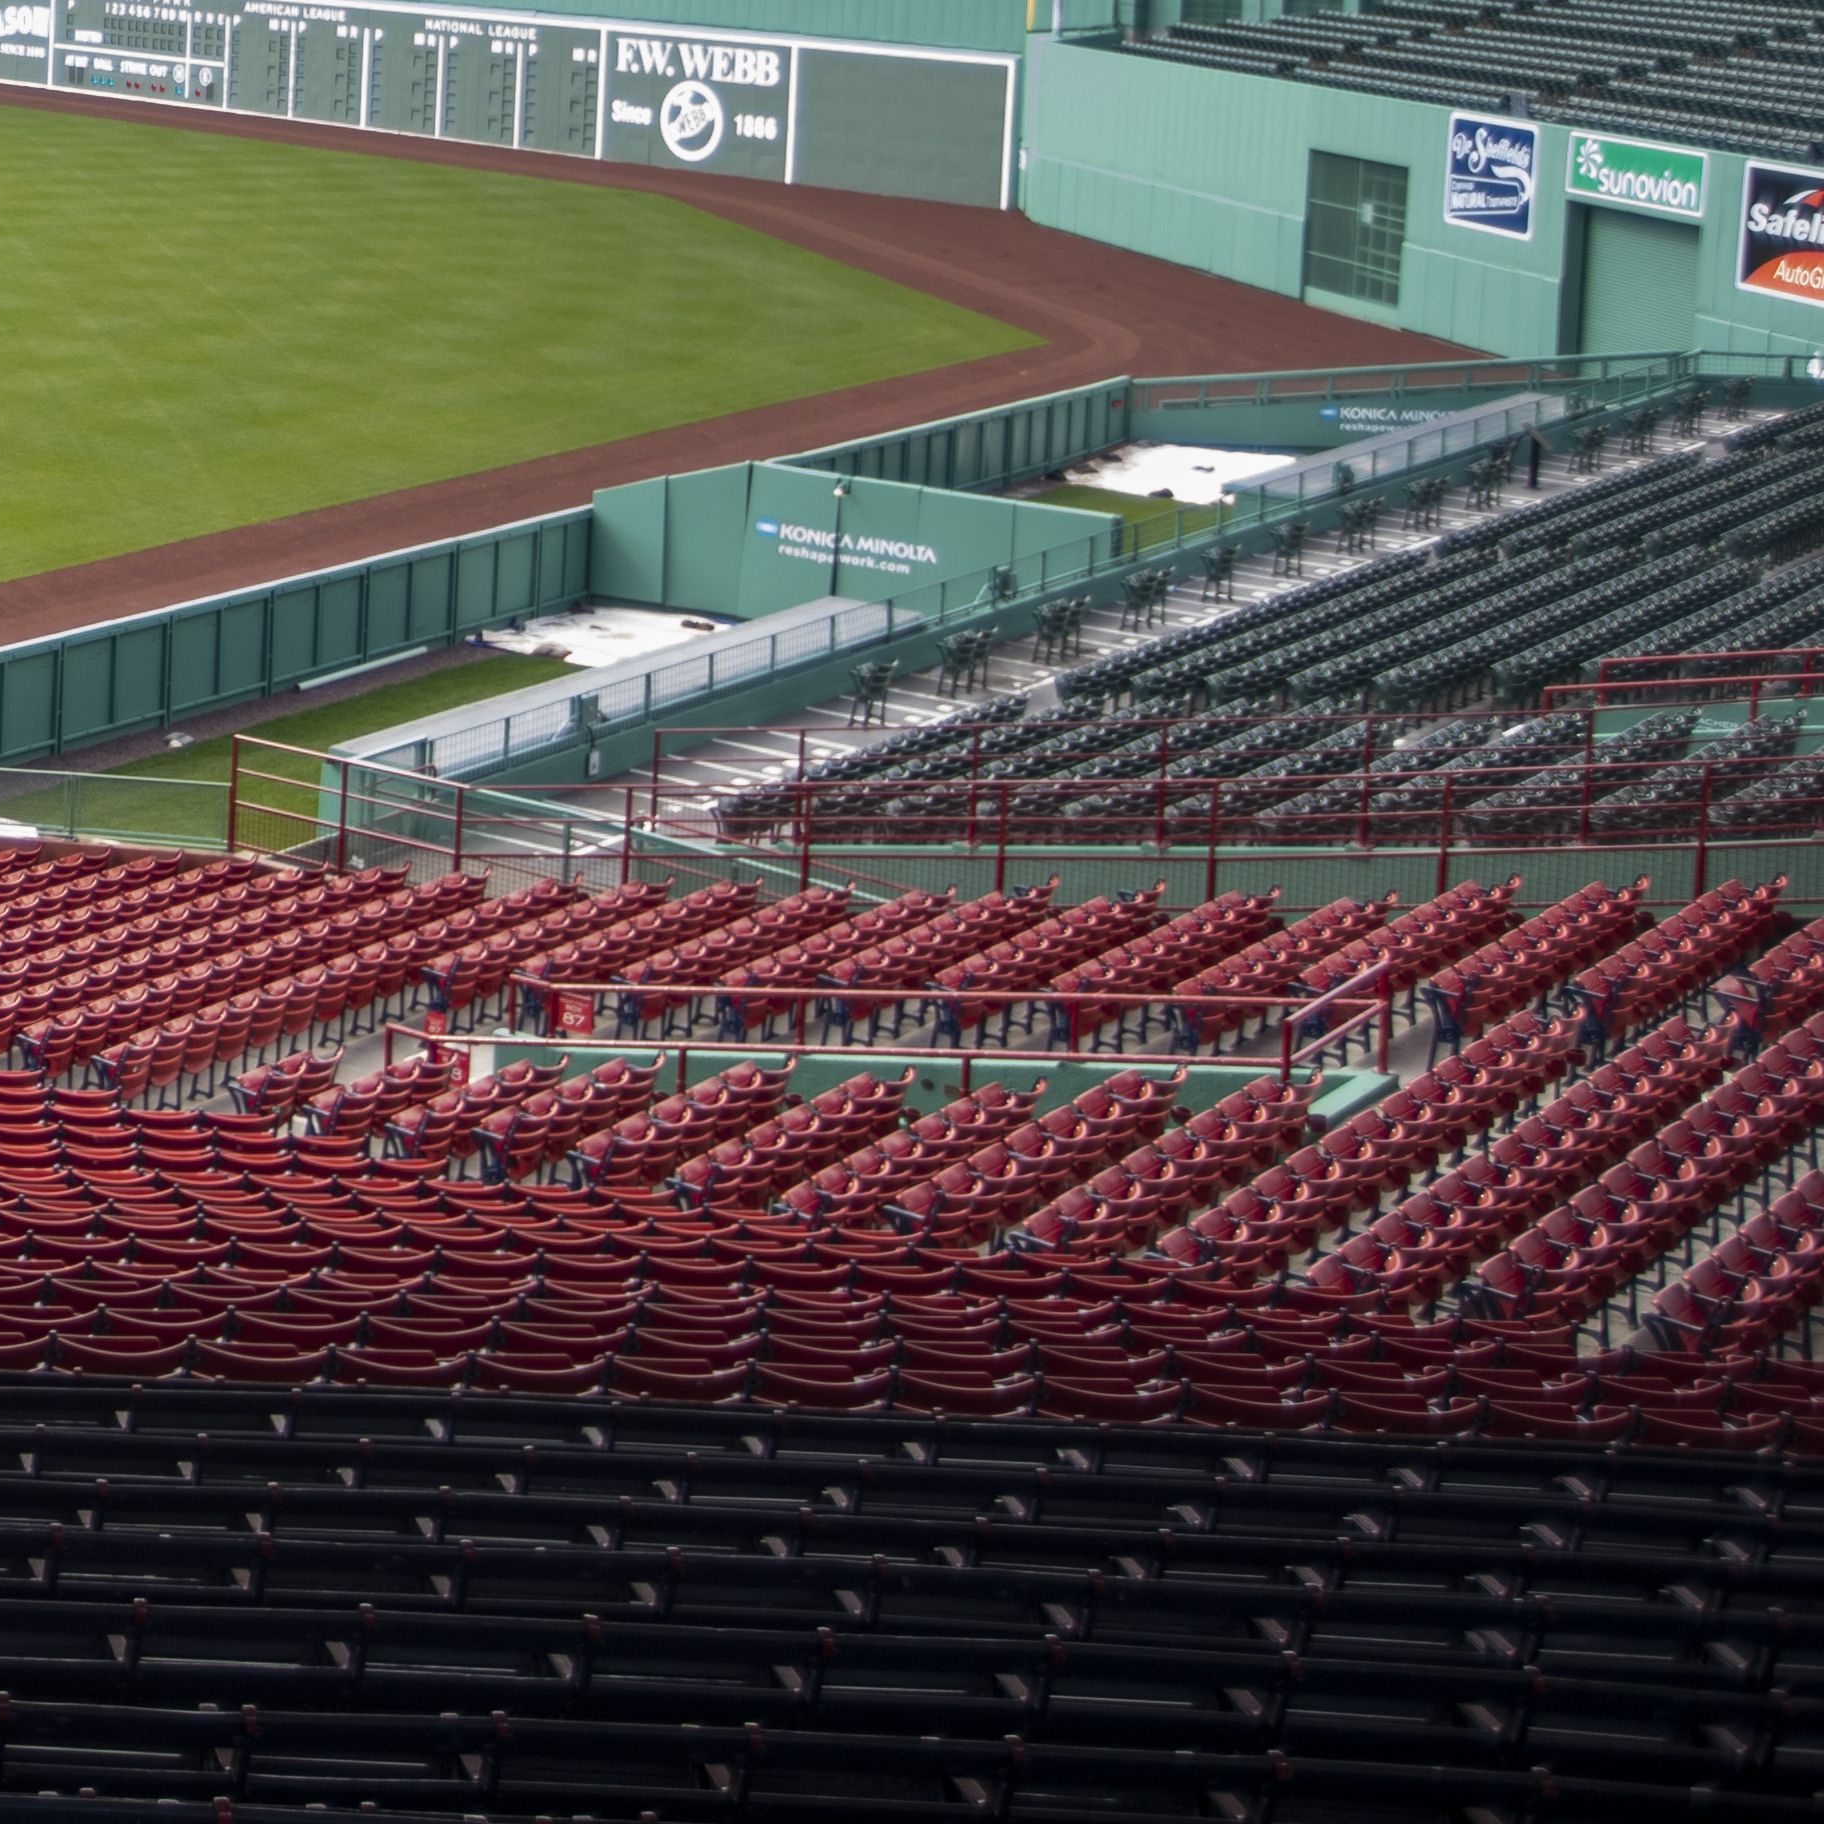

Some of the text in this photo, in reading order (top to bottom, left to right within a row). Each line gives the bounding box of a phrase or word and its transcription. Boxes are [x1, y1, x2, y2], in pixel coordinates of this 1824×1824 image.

[244, 1, 346, 22] AMERICAN LEAGUE
[424, 18, 538, 41] NATIONAL LEAGUE
[149, 64, 168, 77] OUT
[614, 37, 780, 87] F.W. WEBB
[611, 99, 653, 126] Since
[1597, 168, 1697, 208] sunovion
[1339, 406, 1397, 421] KONICA
[779, 523, 937, 564] KONICA MINOLTA
[778, 543, 910, 574] reshapework.com
